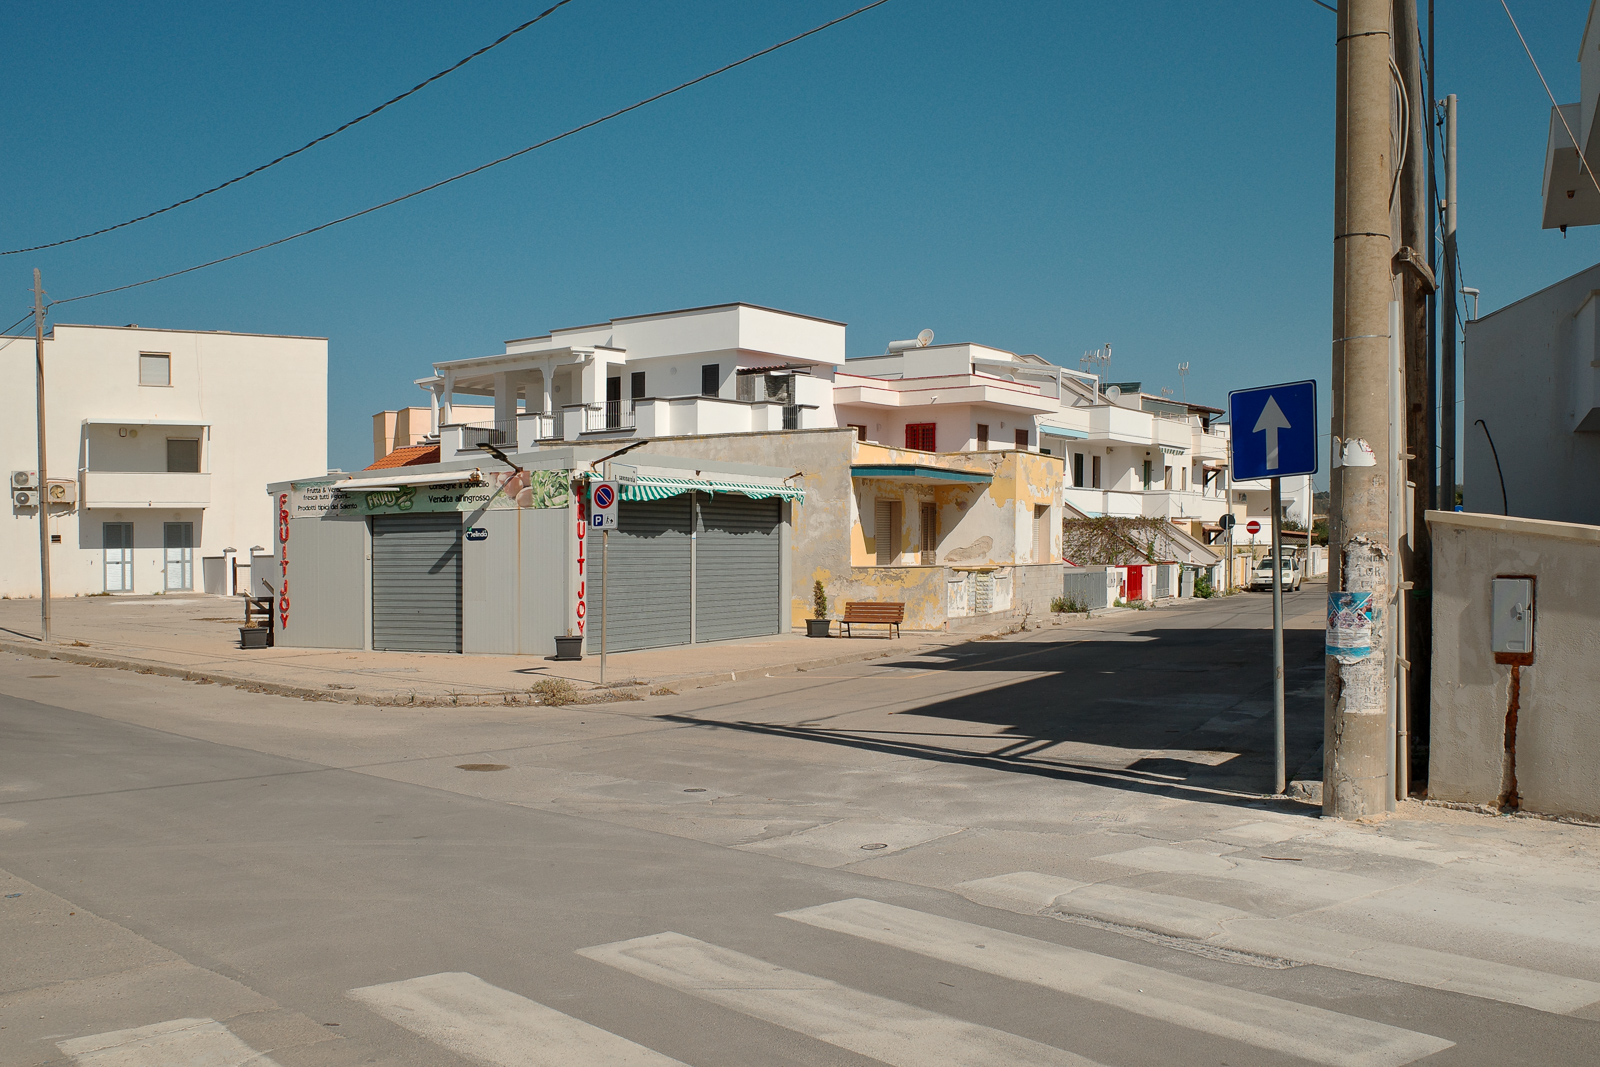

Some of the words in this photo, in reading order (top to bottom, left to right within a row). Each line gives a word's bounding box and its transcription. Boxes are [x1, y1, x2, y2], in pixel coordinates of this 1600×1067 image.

[317, 503, 330, 512] tipici
[340, 502, 358, 510] Salento
[428, 495, 453, 503] Vendita
[454, 494, 491, 503] all'ingrosso
[595, 516, 602, 525] P
[279, 494, 289, 577] FRUIT
[576, 485, 585, 575] FRUIT
[279, 579, 290, 629] JOY
[576, 581, 585, 636] JOY
